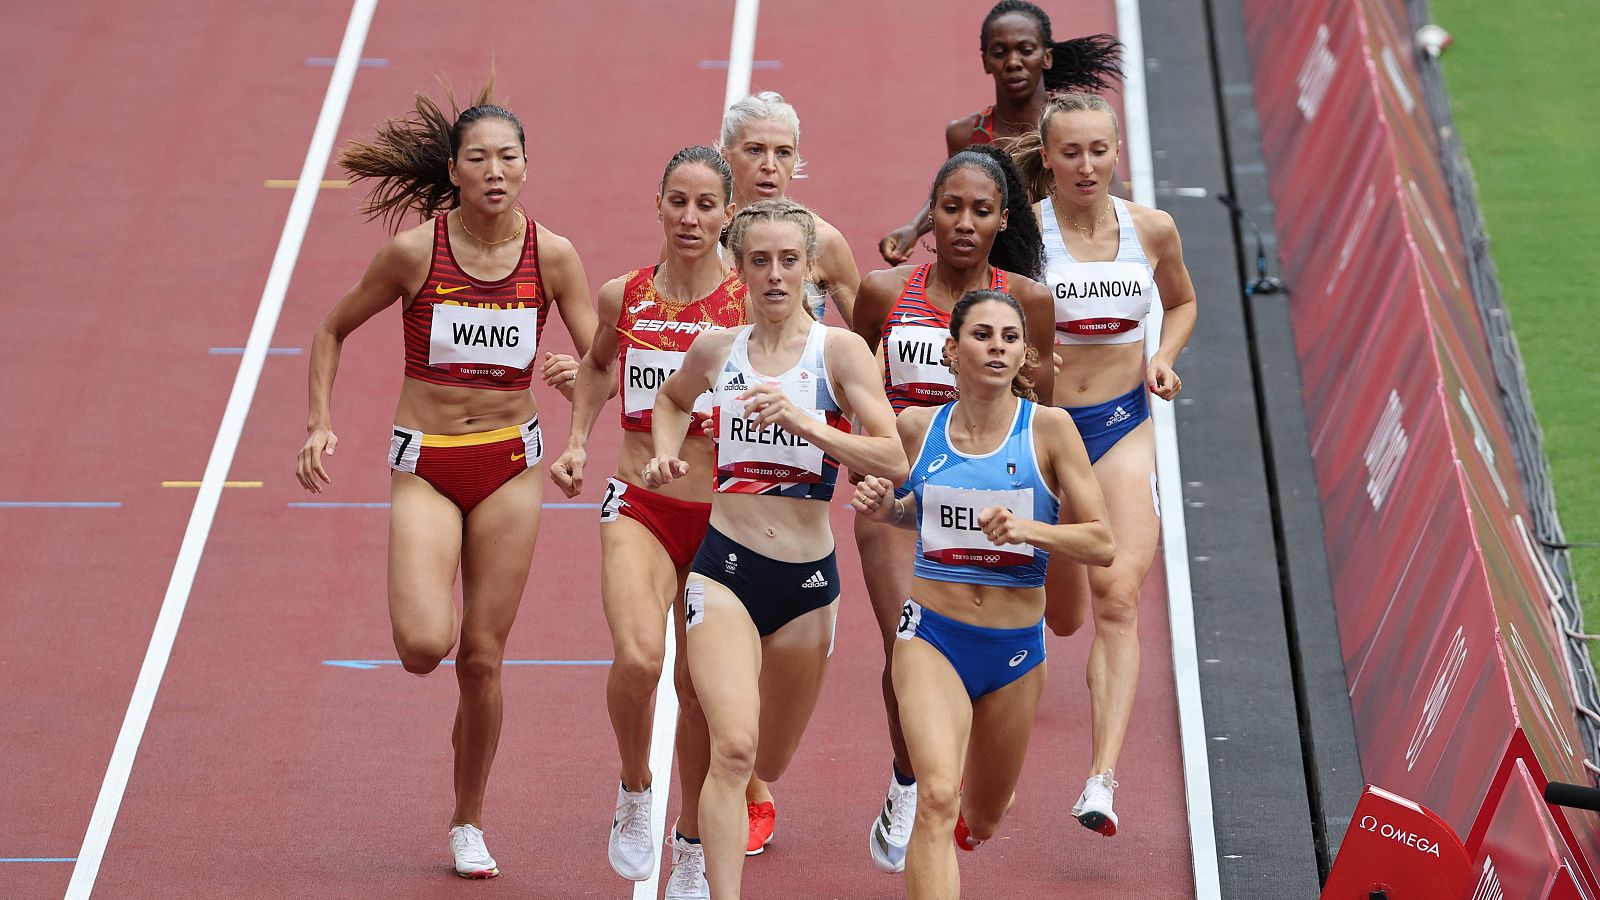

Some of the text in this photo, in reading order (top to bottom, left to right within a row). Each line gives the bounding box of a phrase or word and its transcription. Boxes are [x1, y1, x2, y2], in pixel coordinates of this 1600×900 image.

[1055, 280, 1142, 299] GAJANOVA
[452, 322, 520, 348] WANG
[724, 383, 748, 391] adidas
[915, 387, 931, 395] TOKYO
[393, 429, 413, 466] 7
[743, 467, 760, 475] TOKYO
[600, 482, 616, 518] 2
[940, 504, 1014, 532] BEL
[952, 553, 970, 561] TOKYO
[801, 580, 828, 589] adidas
[1380, 824, 1440, 858] OMEGA
